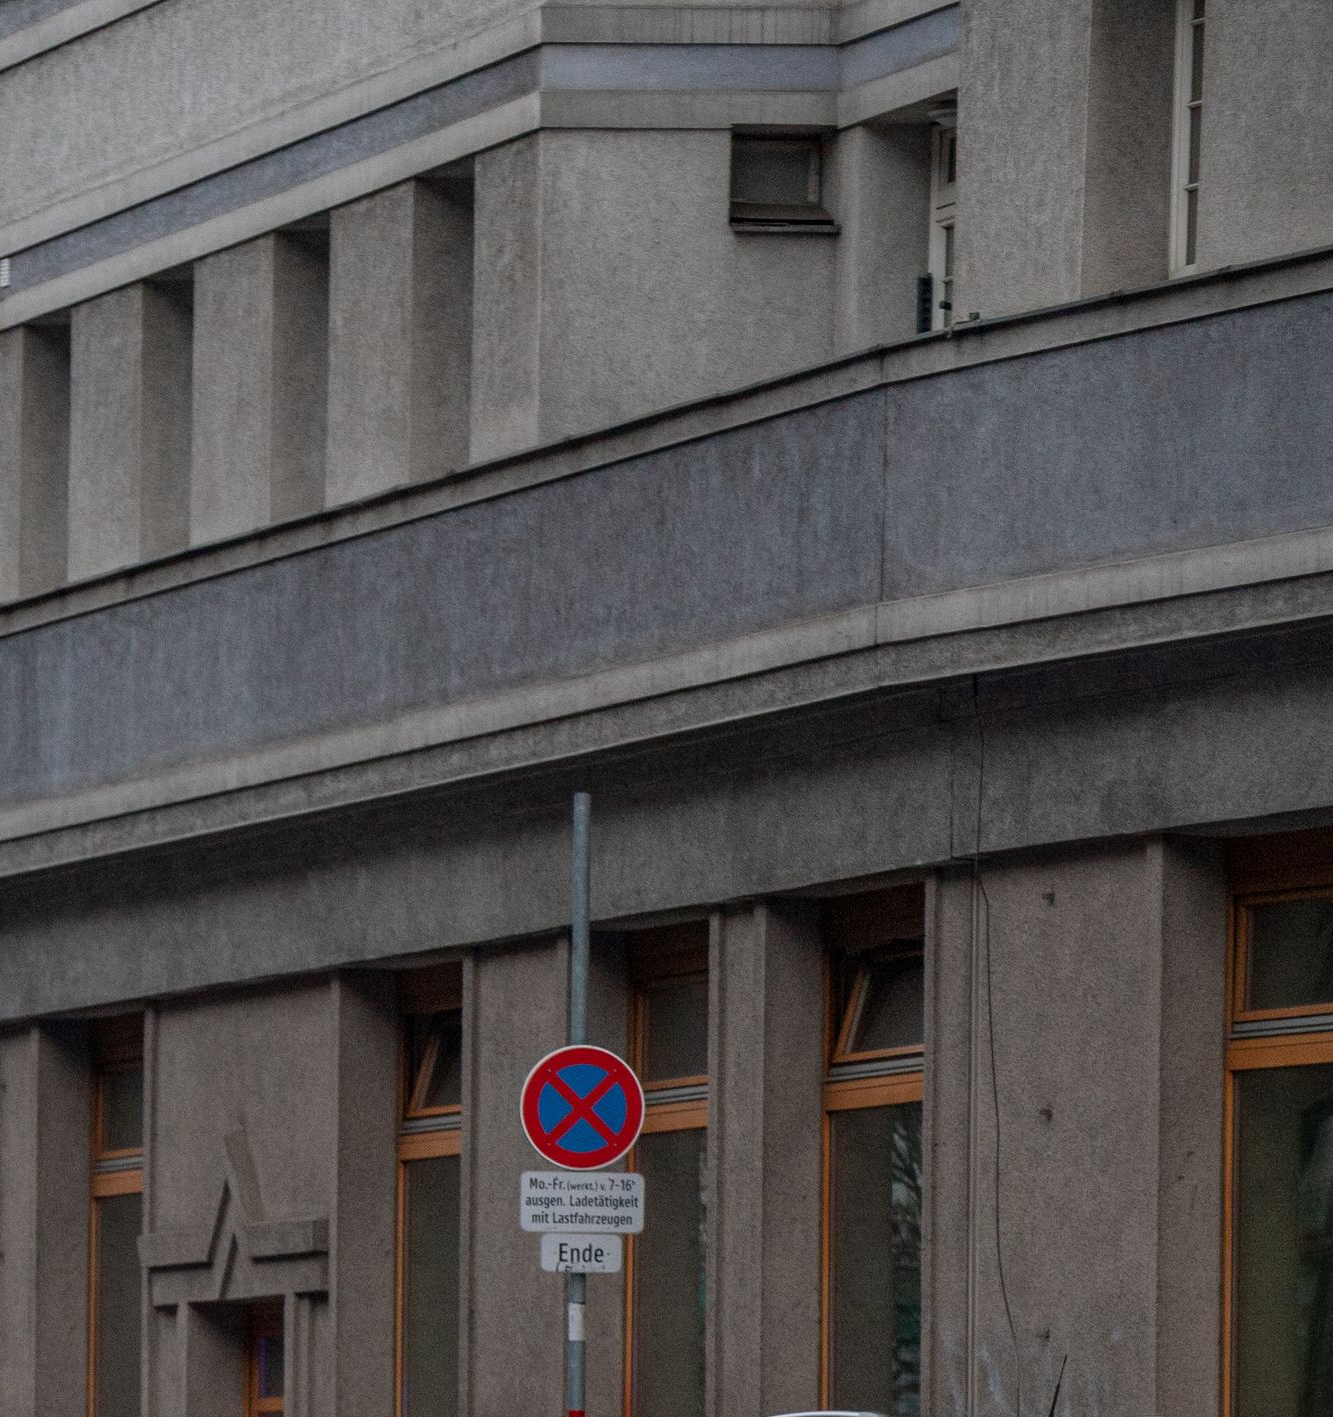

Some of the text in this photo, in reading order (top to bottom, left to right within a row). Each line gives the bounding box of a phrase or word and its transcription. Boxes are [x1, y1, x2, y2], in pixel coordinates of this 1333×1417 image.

[525, 1195, 639, 1211] ausgen. Ladetätigkeit
[532, 1211, 633, 1228] mit Lastfahrzeugen
[558, 1243, 604, 1263] Ende
